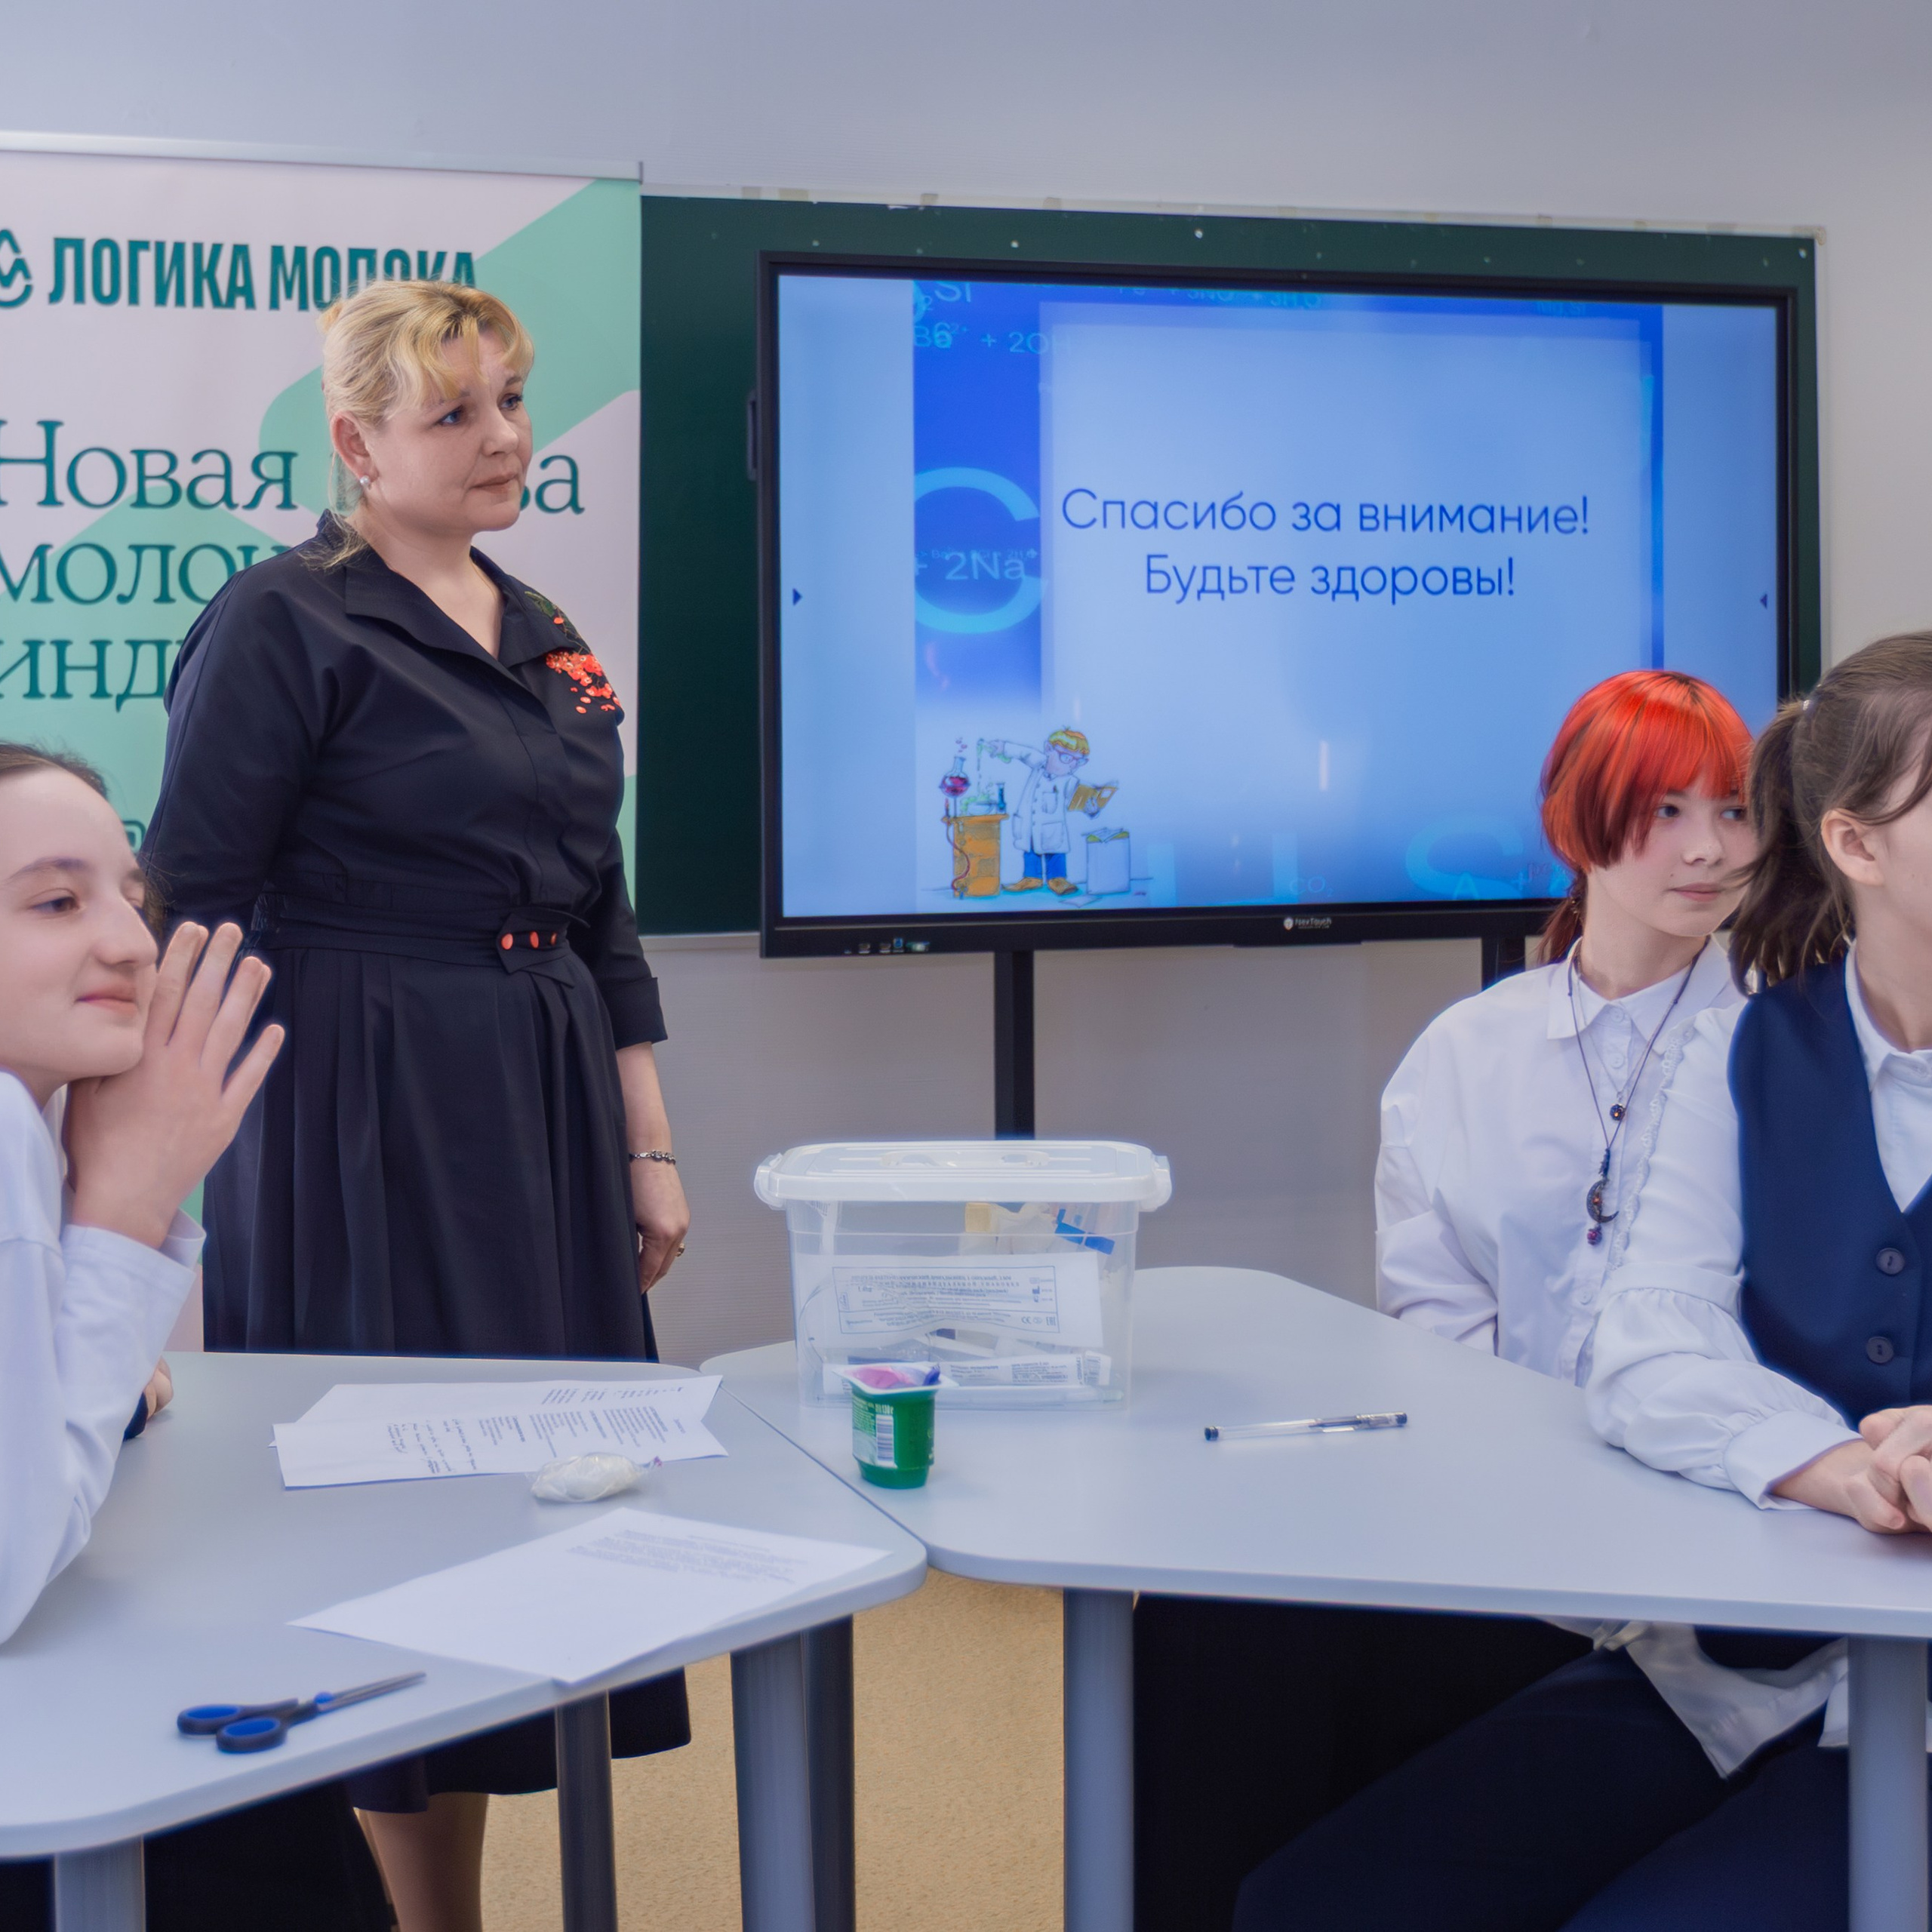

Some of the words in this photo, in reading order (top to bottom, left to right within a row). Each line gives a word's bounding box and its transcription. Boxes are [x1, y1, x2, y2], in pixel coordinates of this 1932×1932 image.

[48, 237, 257, 310] ЛОГИКА
[0, 420, 300, 511] Новая
[1061, 488, 1277, 531] Спасибо
[1291, 500, 1343, 531] за
[1358, 495, 1589, 534] внимание!
[0, 542, 295, 605] моло
[1145, 553, 1296, 605] Будьте
[1309, 557, 1515, 605] здоровы!
[0, 638, 183, 713] инд
